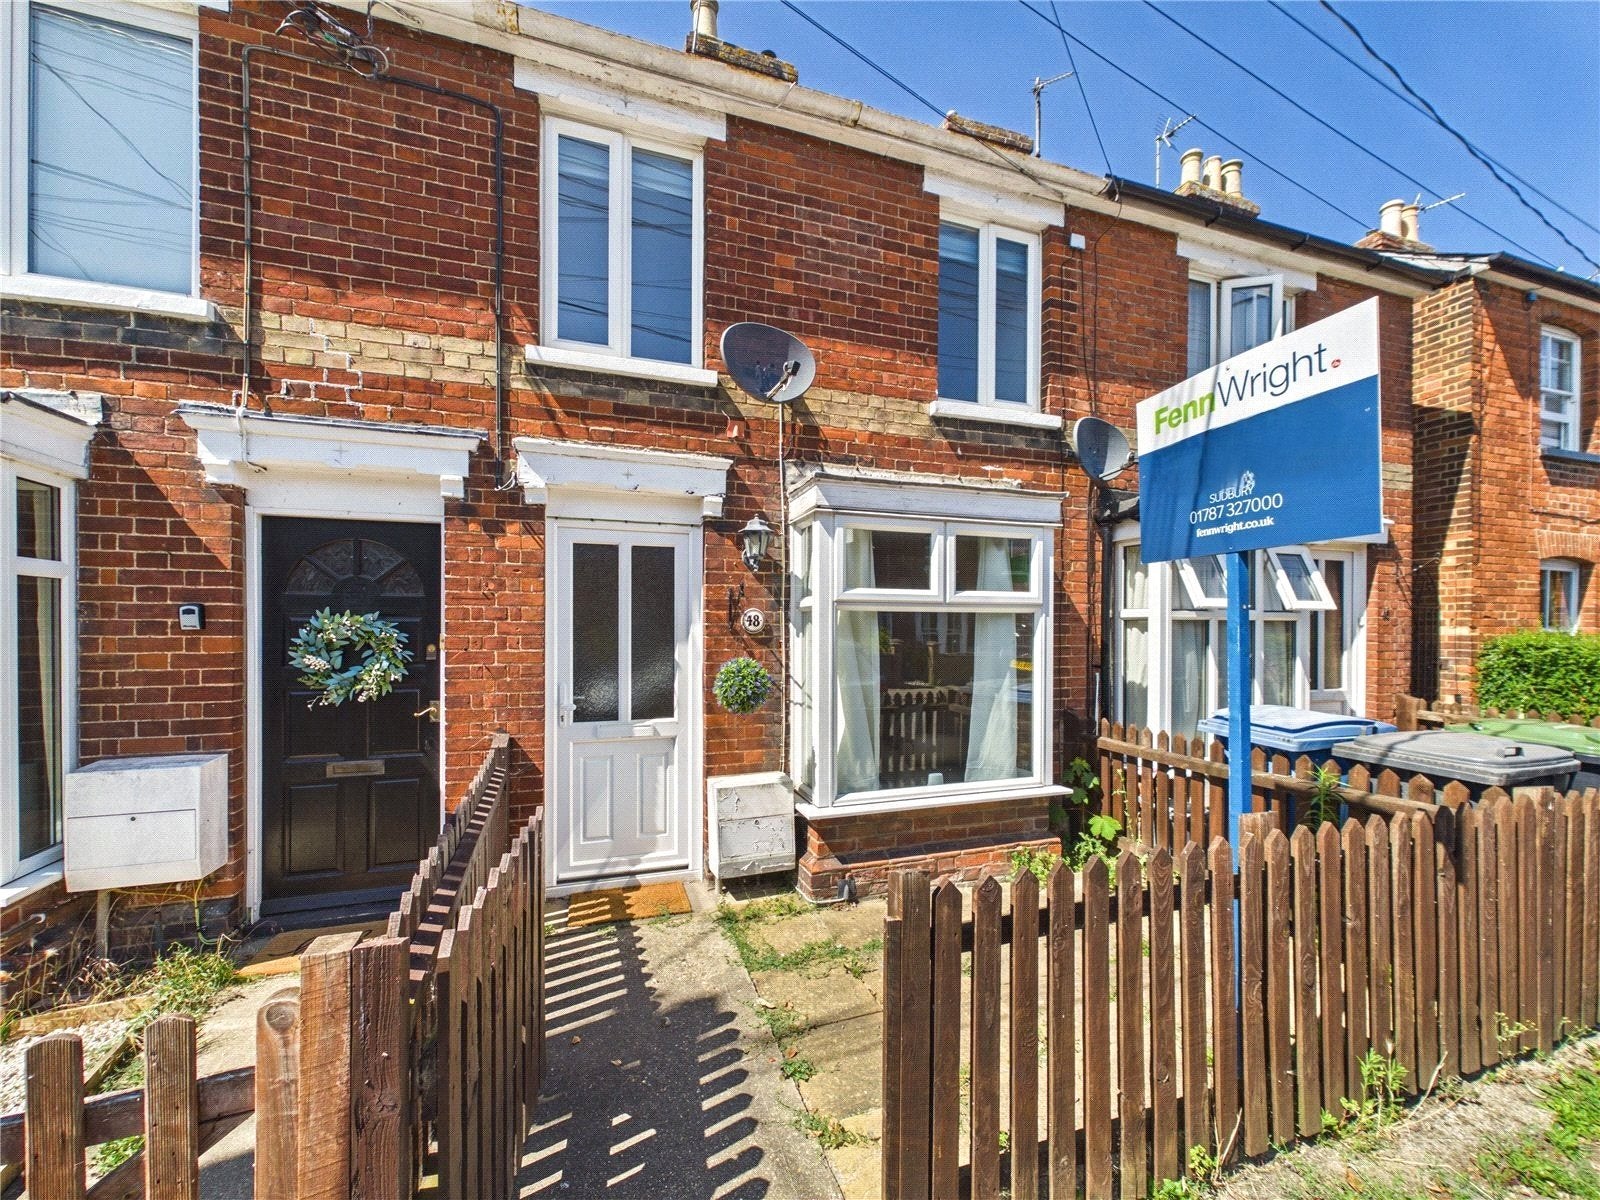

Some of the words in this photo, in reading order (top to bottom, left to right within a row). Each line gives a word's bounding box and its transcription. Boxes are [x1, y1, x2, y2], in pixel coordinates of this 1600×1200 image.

[1209, 484, 1255, 504] SUDBURY
[1189, 504, 1224, 525] 01787
[1226, 493, 1283, 517] 327000
[1196, 515, 1275, 538] fennwright.co.uk
[746, 614, 761, 628] 48
